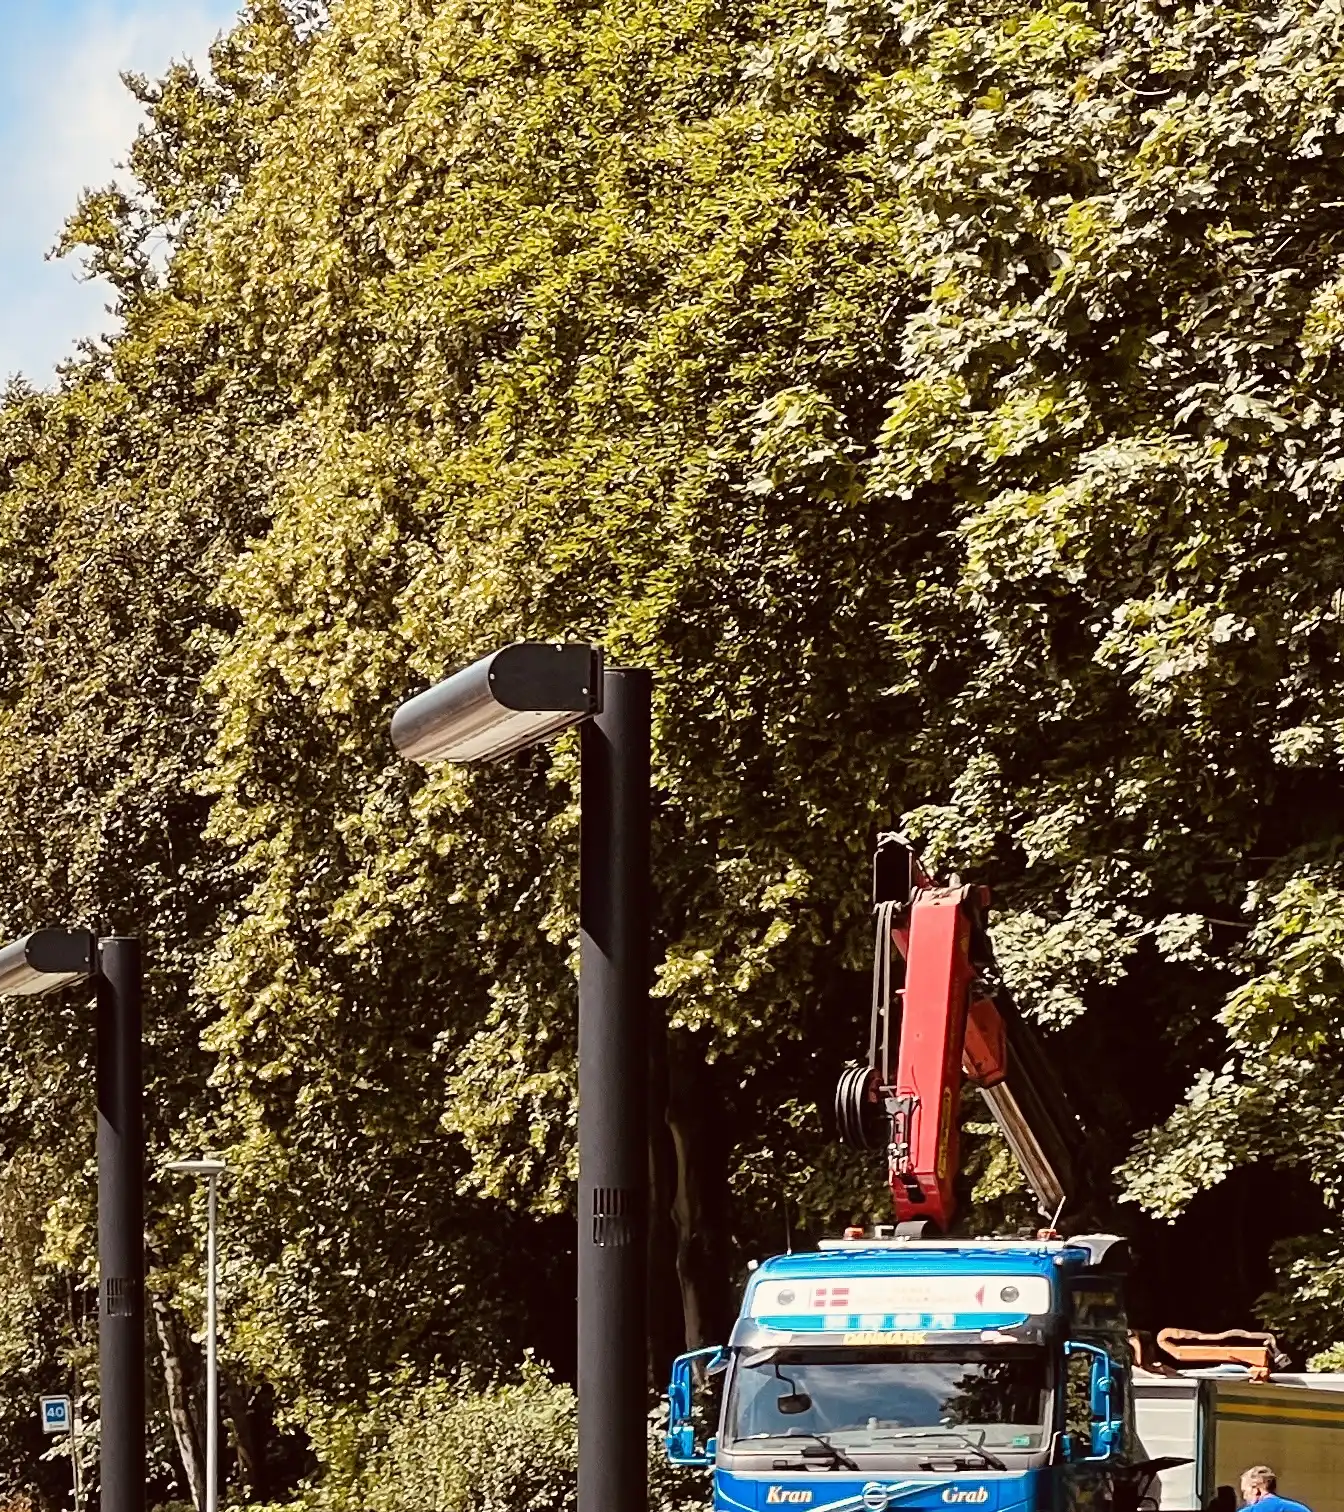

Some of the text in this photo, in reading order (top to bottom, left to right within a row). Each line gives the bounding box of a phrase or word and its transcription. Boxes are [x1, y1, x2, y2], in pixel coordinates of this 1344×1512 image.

[47, 1407, 64, 1418] 40
[766, 1485, 812, 1504] Kran
[941, 1485, 989, 1503] Grab
